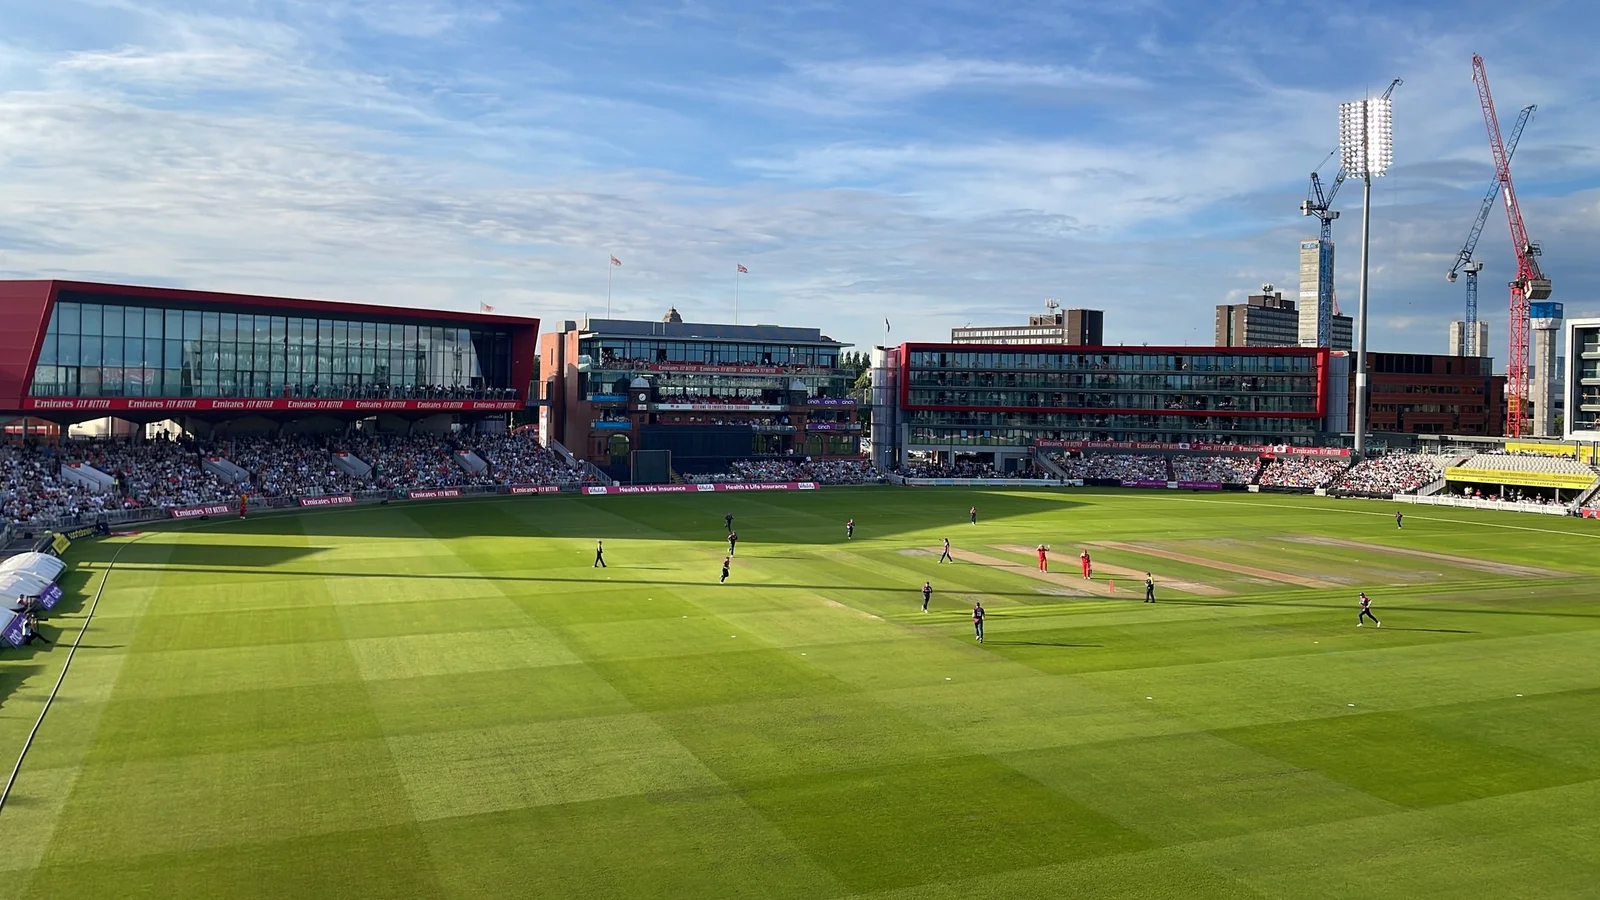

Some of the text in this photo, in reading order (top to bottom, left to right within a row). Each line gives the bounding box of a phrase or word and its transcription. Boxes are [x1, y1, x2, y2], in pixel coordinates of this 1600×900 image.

[34, 400, 110, 408] Emirates FLY BETTER
[128, 400, 197, 408] Emirates FLY BETTER
[212, 400, 244, 408] Emirates
[302, 498, 330, 506] Emirates
[174, 508, 204, 517] Emirates
